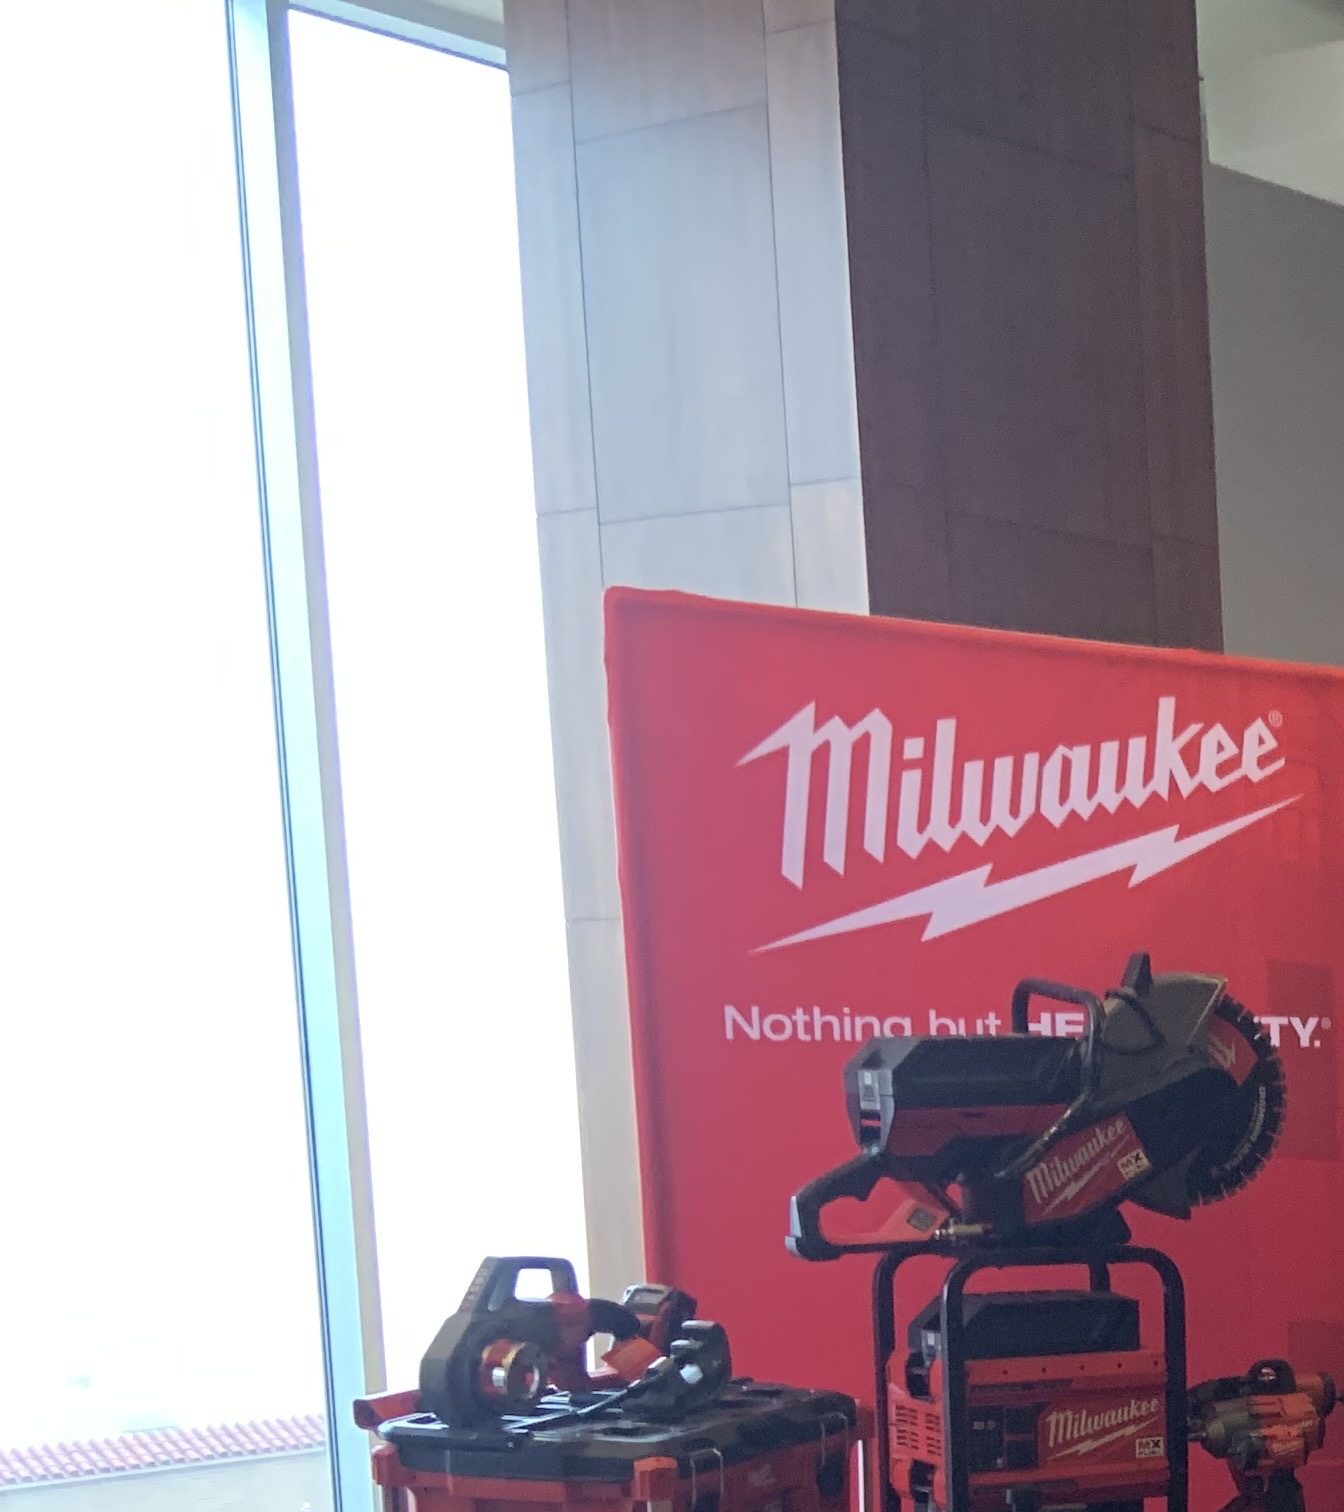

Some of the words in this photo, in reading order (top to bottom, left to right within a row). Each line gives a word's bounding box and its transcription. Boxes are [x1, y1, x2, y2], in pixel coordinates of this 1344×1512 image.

[724, 1004, 912, 1042] Nothing
[1025, 1120, 1125, 1205] Milwaukee
[1045, 1398, 1159, 1448] Milwaukee
